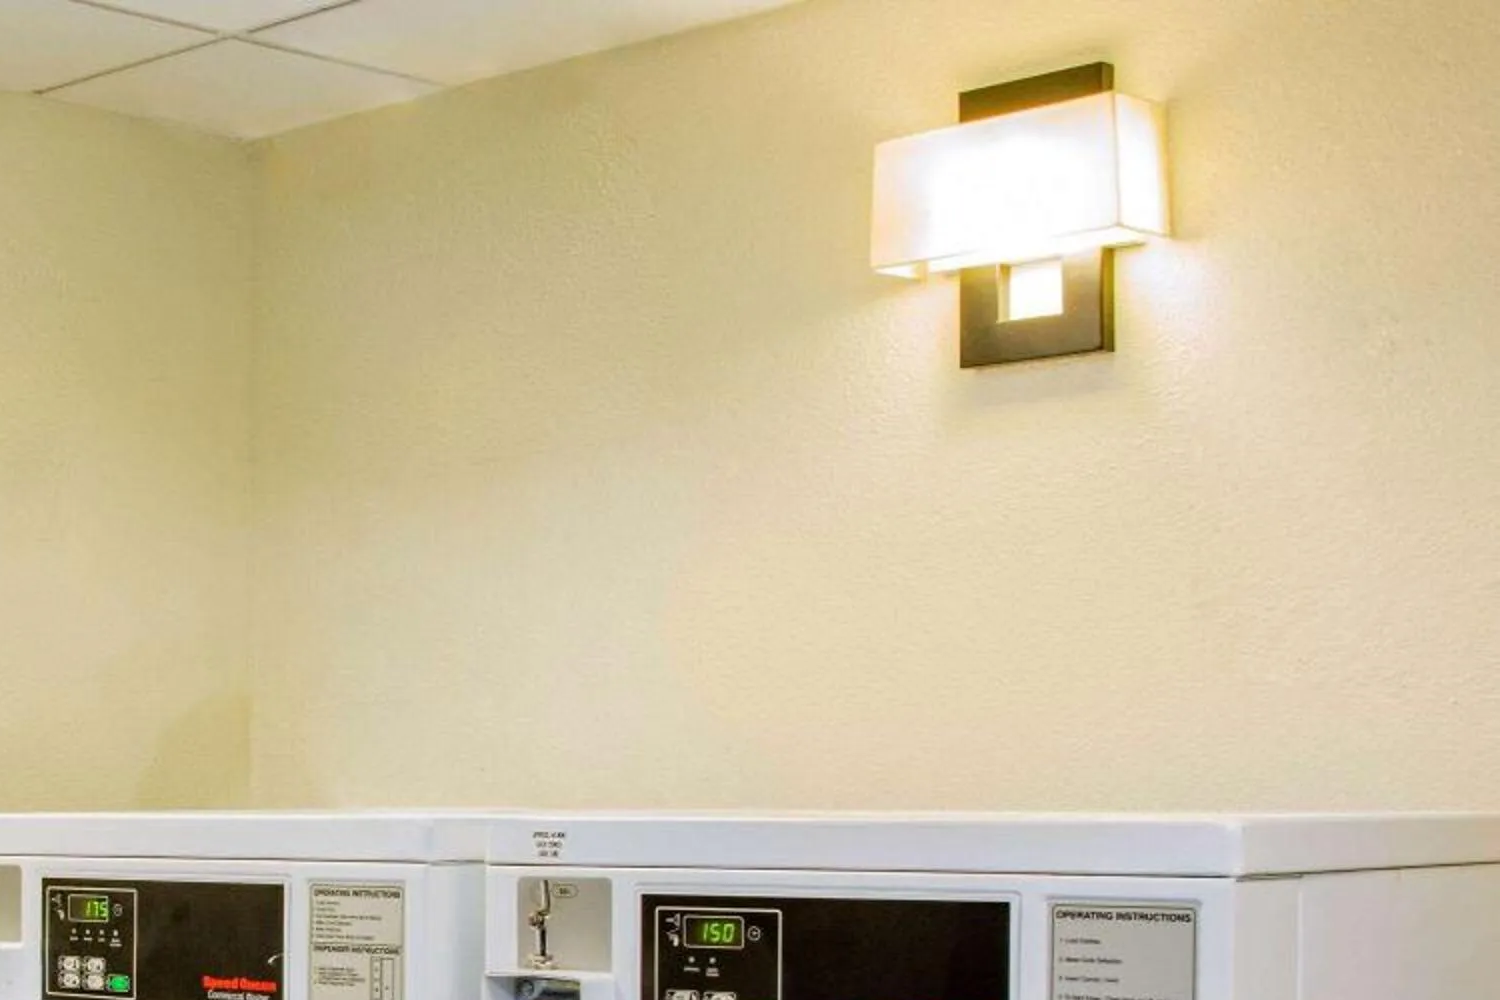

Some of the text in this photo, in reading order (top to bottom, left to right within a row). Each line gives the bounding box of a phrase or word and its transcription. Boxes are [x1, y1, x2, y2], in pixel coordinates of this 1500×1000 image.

[1055, 910, 1192, 923] OPERATING INSTRUCTIONS
[703, 923, 735, 942] 150
